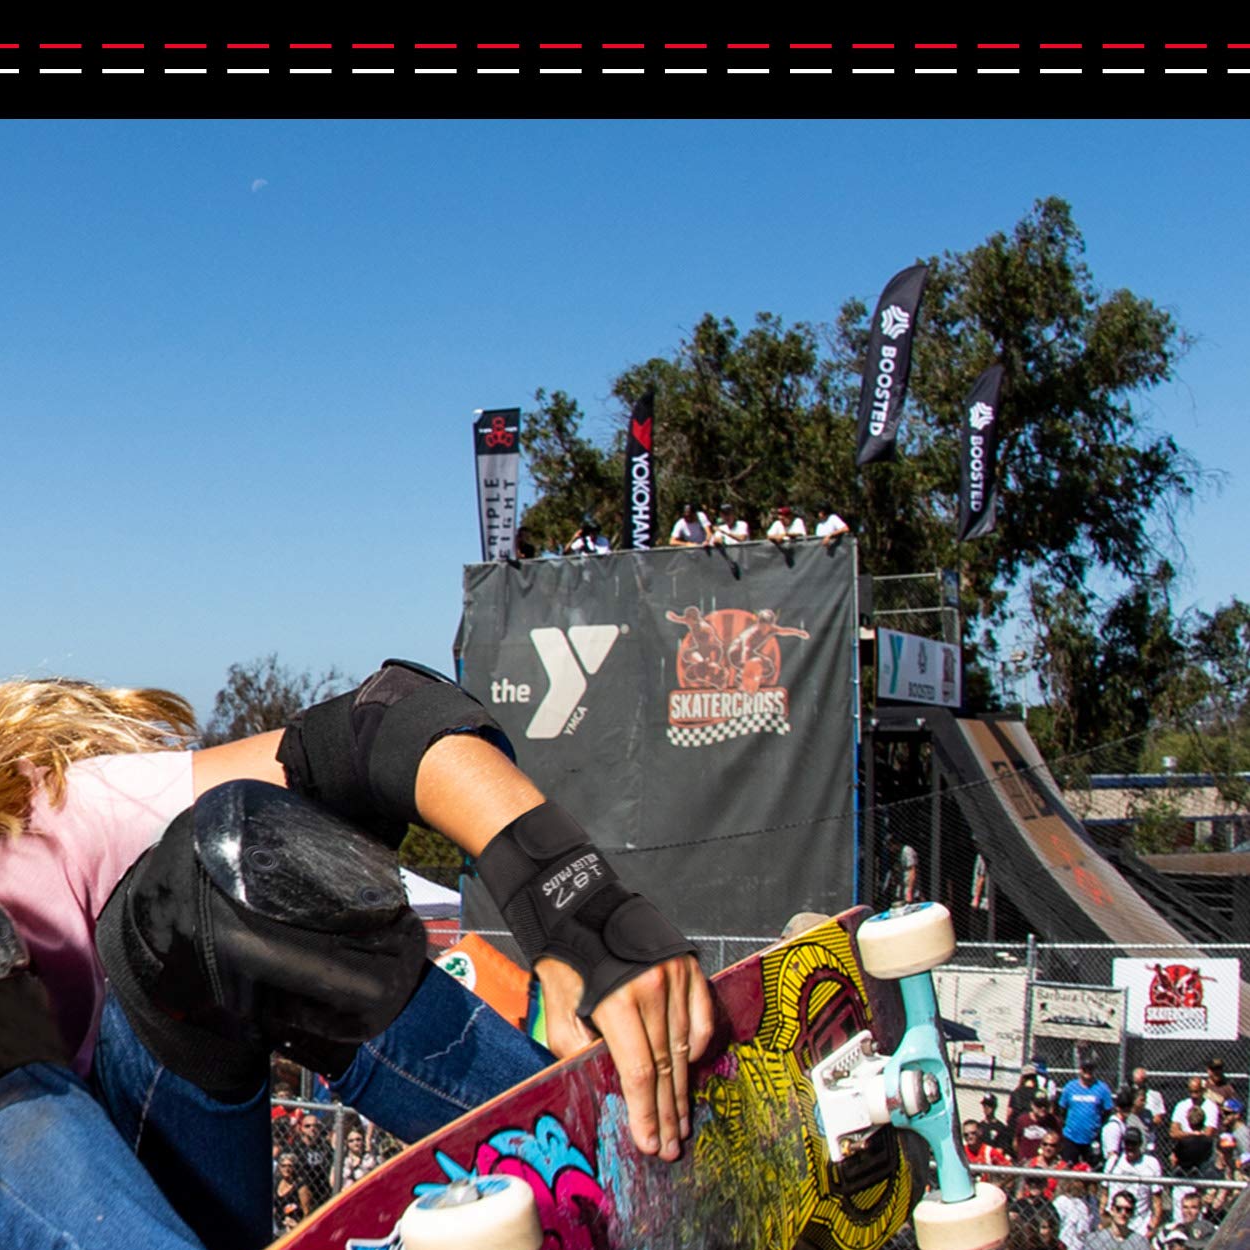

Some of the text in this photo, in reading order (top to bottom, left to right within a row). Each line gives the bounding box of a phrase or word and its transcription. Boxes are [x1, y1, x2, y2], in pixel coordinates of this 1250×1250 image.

[870, 345, 897, 436] BOOSTED
[970, 435, 984, 512] BOOSTED
[491, 678, 531, 703] the
[670, 691, 785, 719] SKATERCROSS
[563, 705, 588, 736] YMCA
[542, 866, 573, 896] PADS
[556, 864, 603, 908] 187
